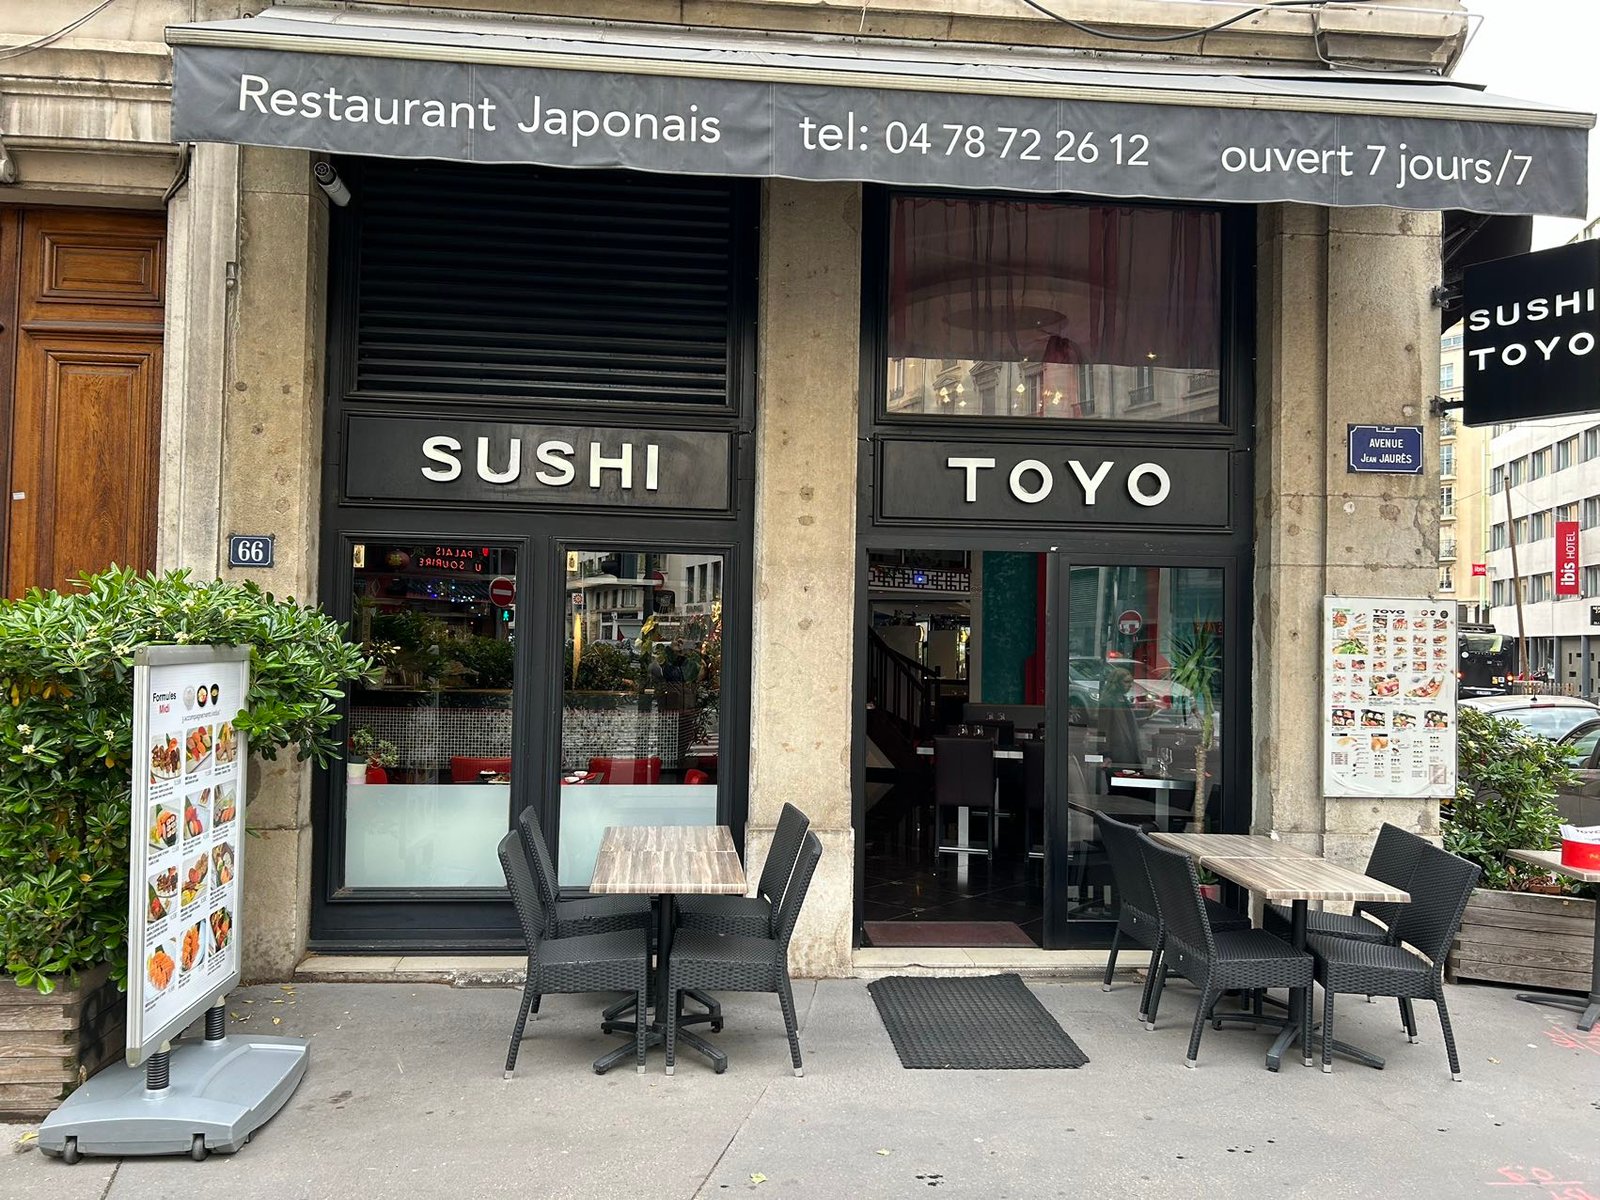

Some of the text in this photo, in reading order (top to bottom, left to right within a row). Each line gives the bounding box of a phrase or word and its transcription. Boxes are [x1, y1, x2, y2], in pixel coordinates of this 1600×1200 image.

[238, 73, 721, 147] Restaurant Japonais
[798, 111, 1150, 166] tel: 04 78 72 26 12
[1220, 143, 1533, 189] ouvert 7 jours/7
[1468, 287, 1595, 332] SUSHI
[1468, 331, 1595, 371] TOYO
[420, 434, 659, 490] SUSHI
[1369, 438, 1404, 448] AVENUE
[1379, 453, 1412, 464] JAURÈS
[947, 456, 1171, 507] TOYO
[238, 540, 264, 562] 66
[1560, 531, 1576, 586] ibis HOTEL
[152, 691, 177, 703] Formules
